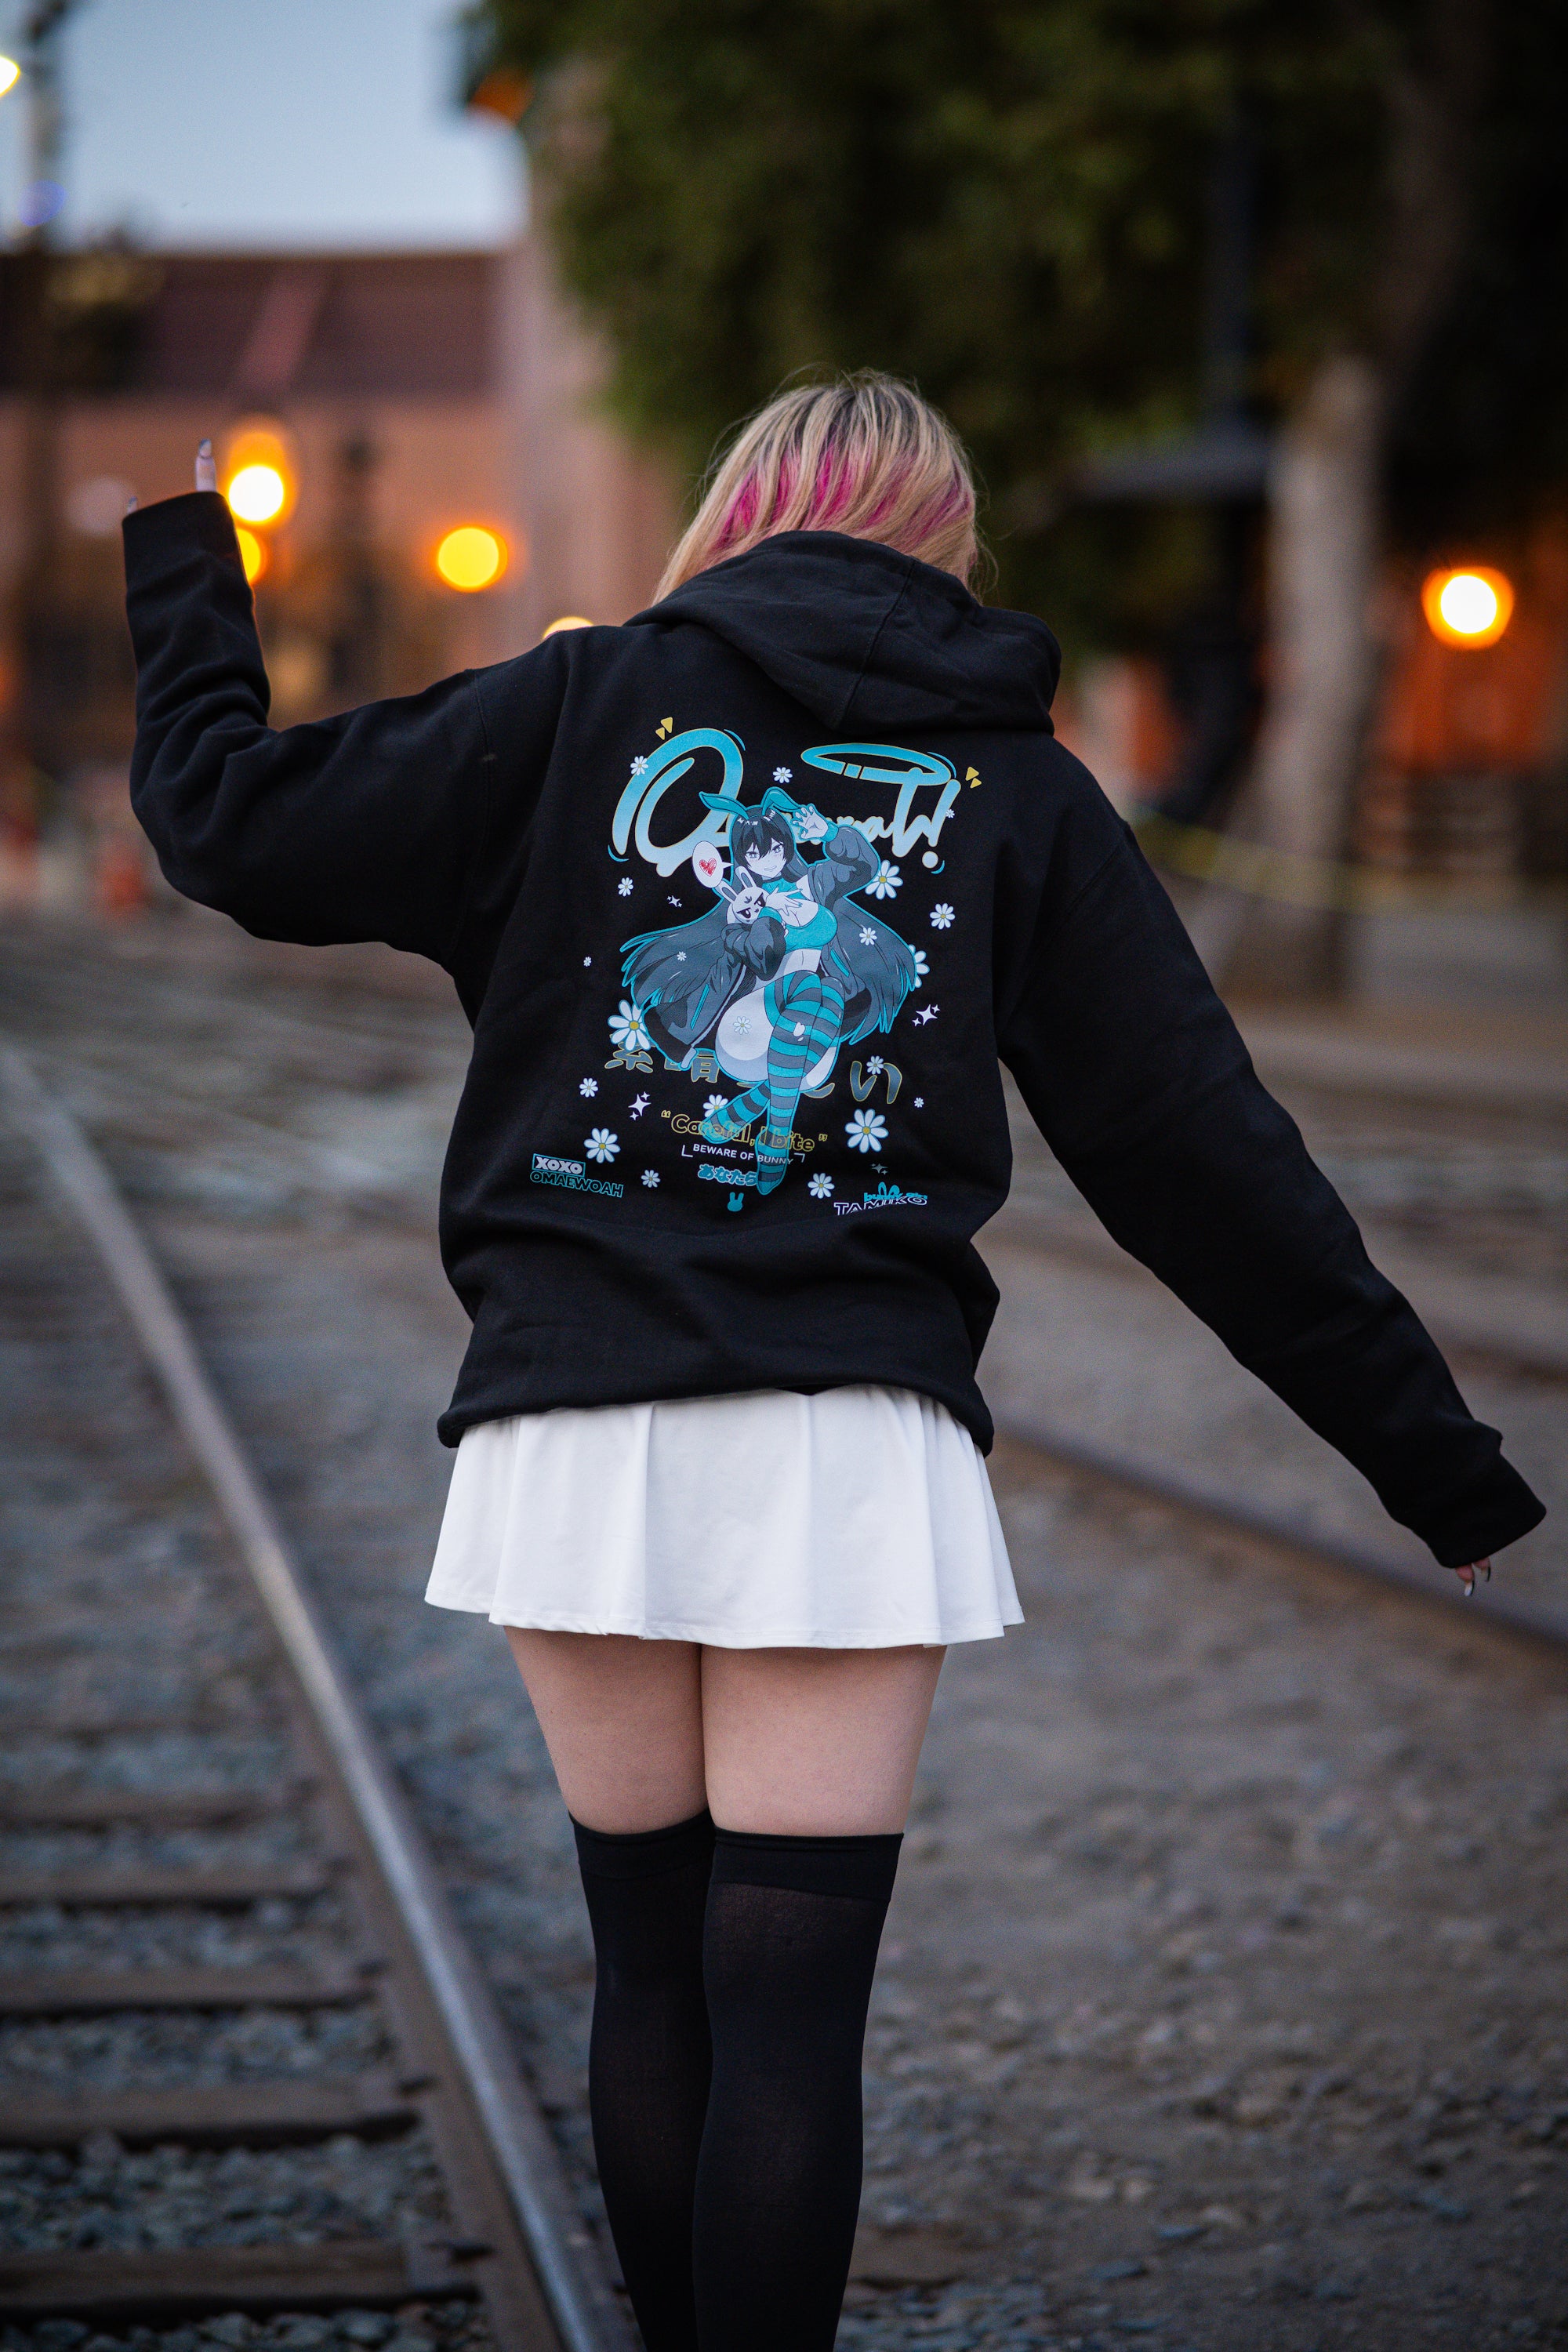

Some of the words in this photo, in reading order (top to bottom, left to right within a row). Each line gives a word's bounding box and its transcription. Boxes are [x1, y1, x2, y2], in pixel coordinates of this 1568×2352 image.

[692, 1143, 738, 1159] BEWARE
[739, 1151, 755, 1161] OF
[757, 1154, 794, 1165] BUNNY
[535, 1156, 583, 1175] XOXO
[529, 1170, 624, 1199] OMAEWOAH
[833, 1196, 927, 1216] TAMIKO
